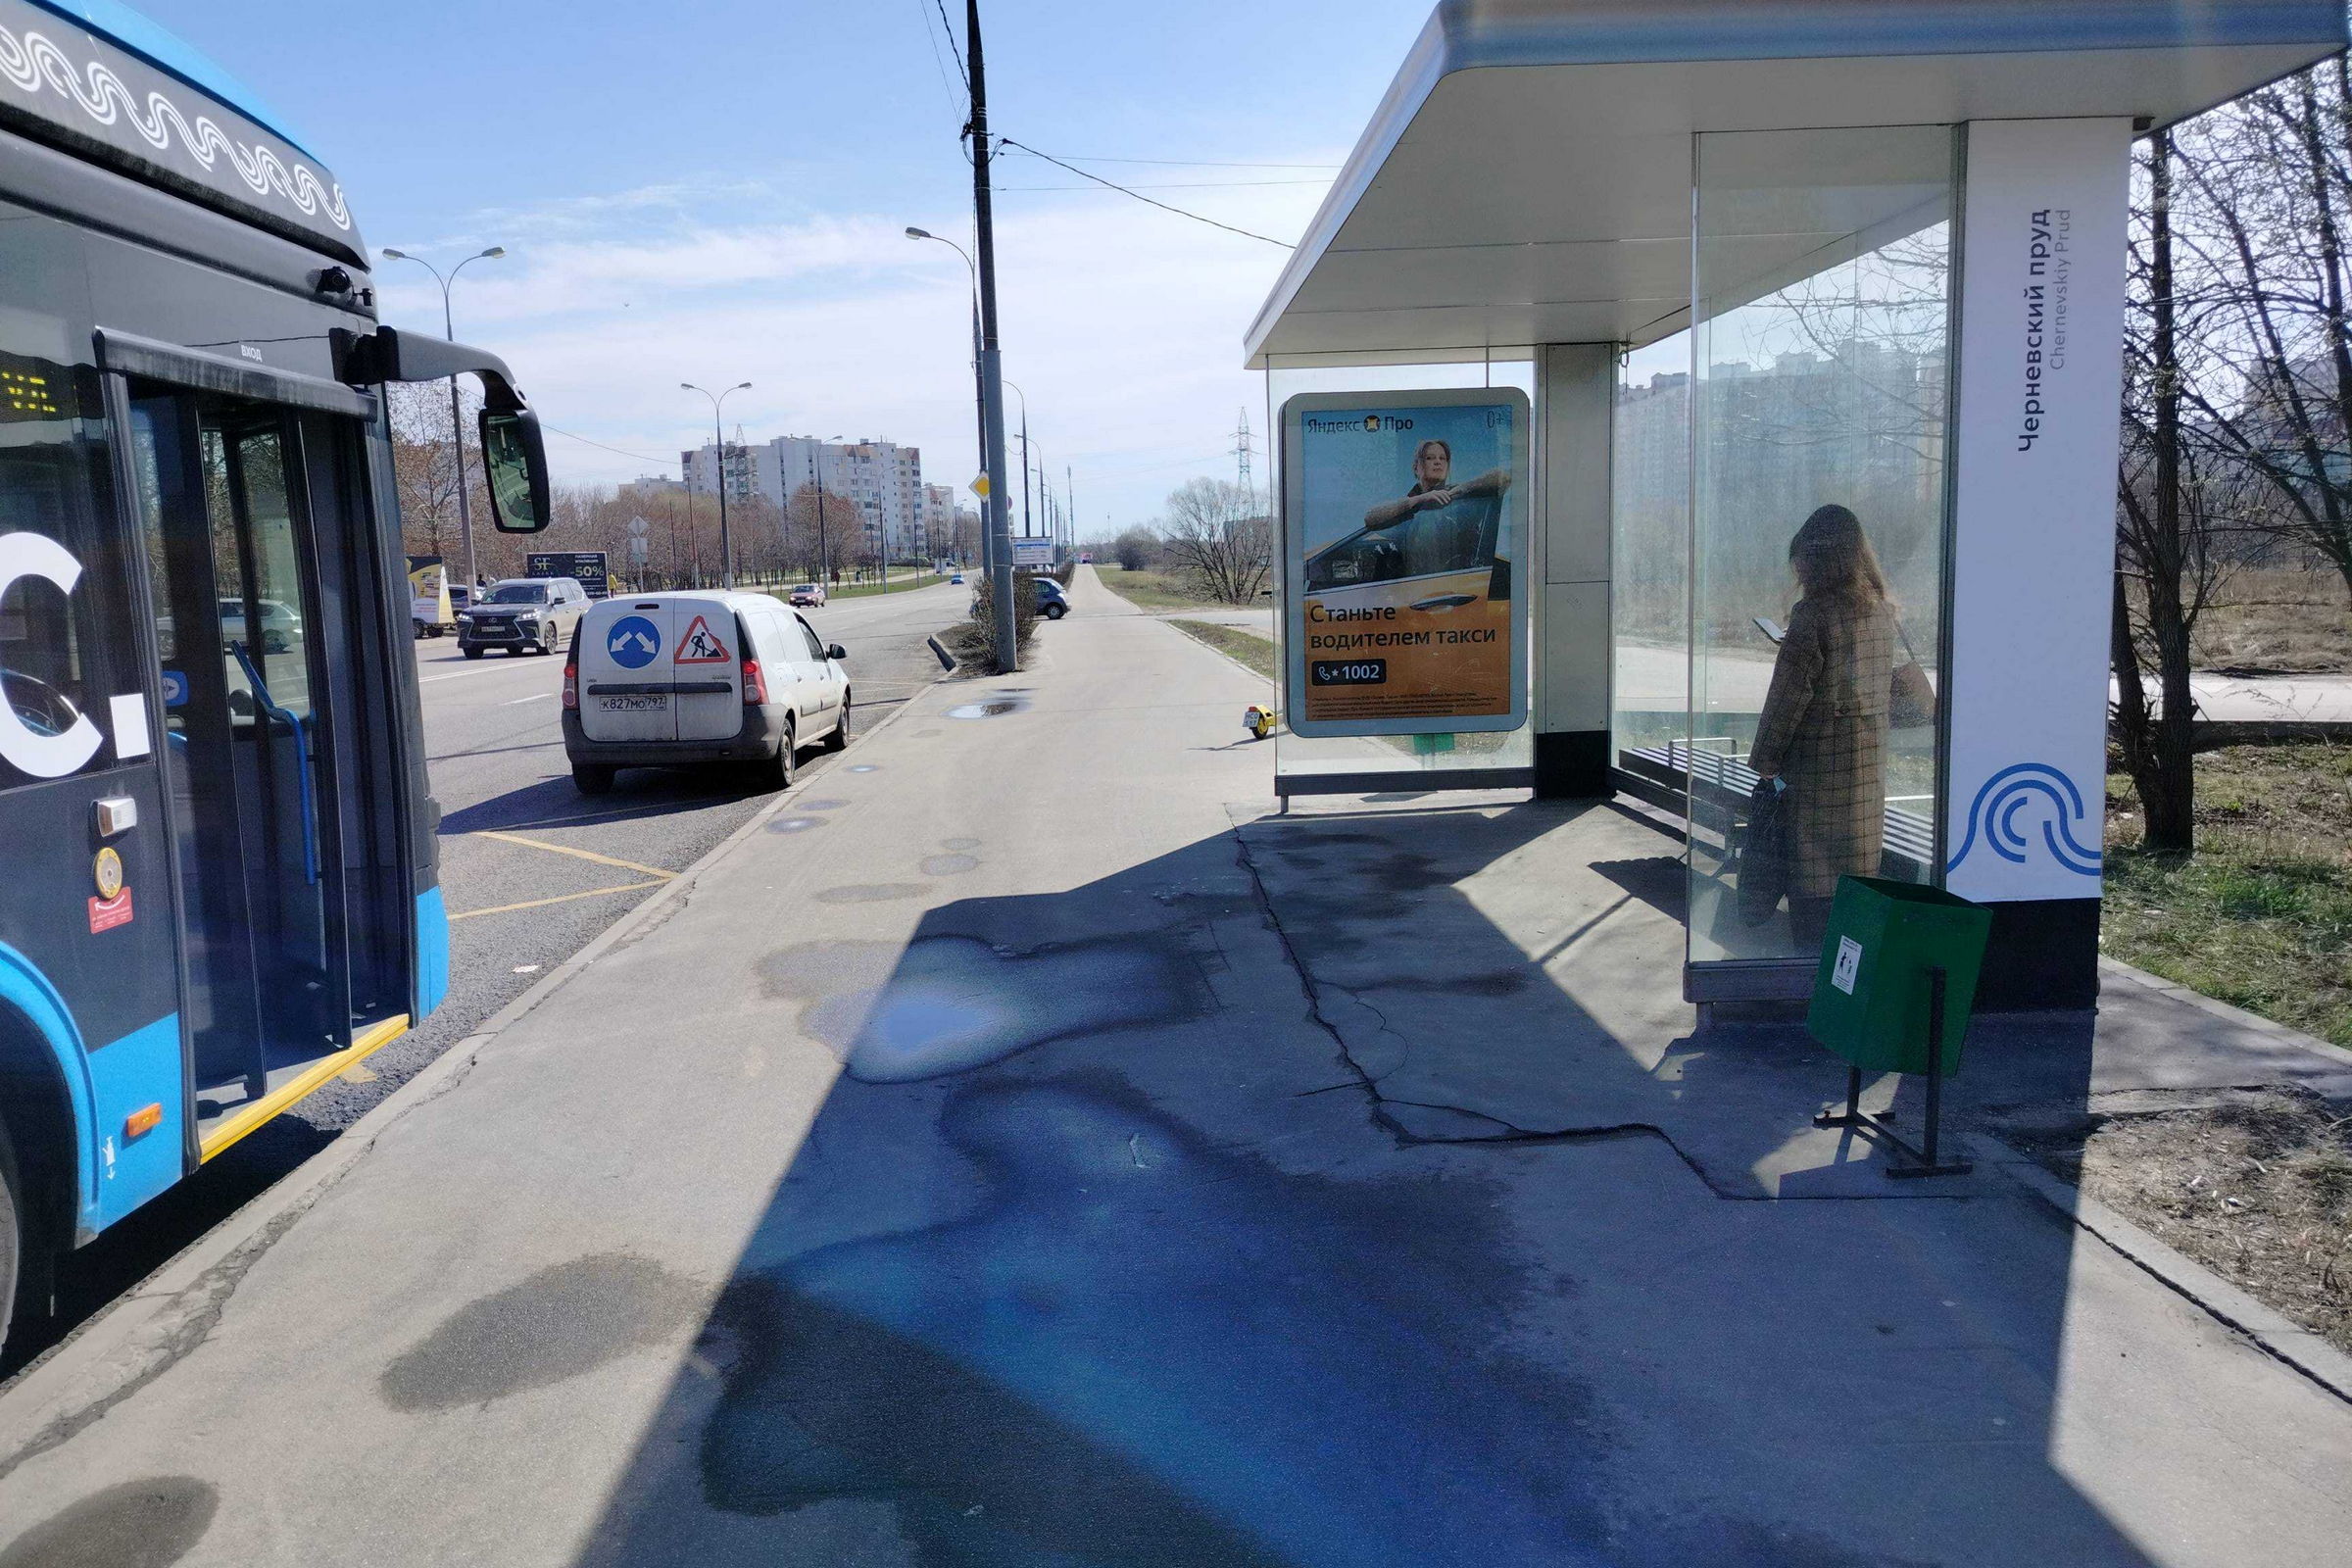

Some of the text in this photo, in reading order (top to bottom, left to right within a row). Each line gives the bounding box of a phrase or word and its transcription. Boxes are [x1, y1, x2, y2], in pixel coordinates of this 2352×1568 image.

[2050, 210, 2071, 370] Chernevskiy Prud
[2018, 209, 2051, 452] Черневский пруд
[1307, 416, 1414, 432] Яндекс Про
[1487, 410, 1504, 429] 0+
[1310, 605, 1396, 622] Станьте
[1310, 628, 1495, 651] водителем такси
